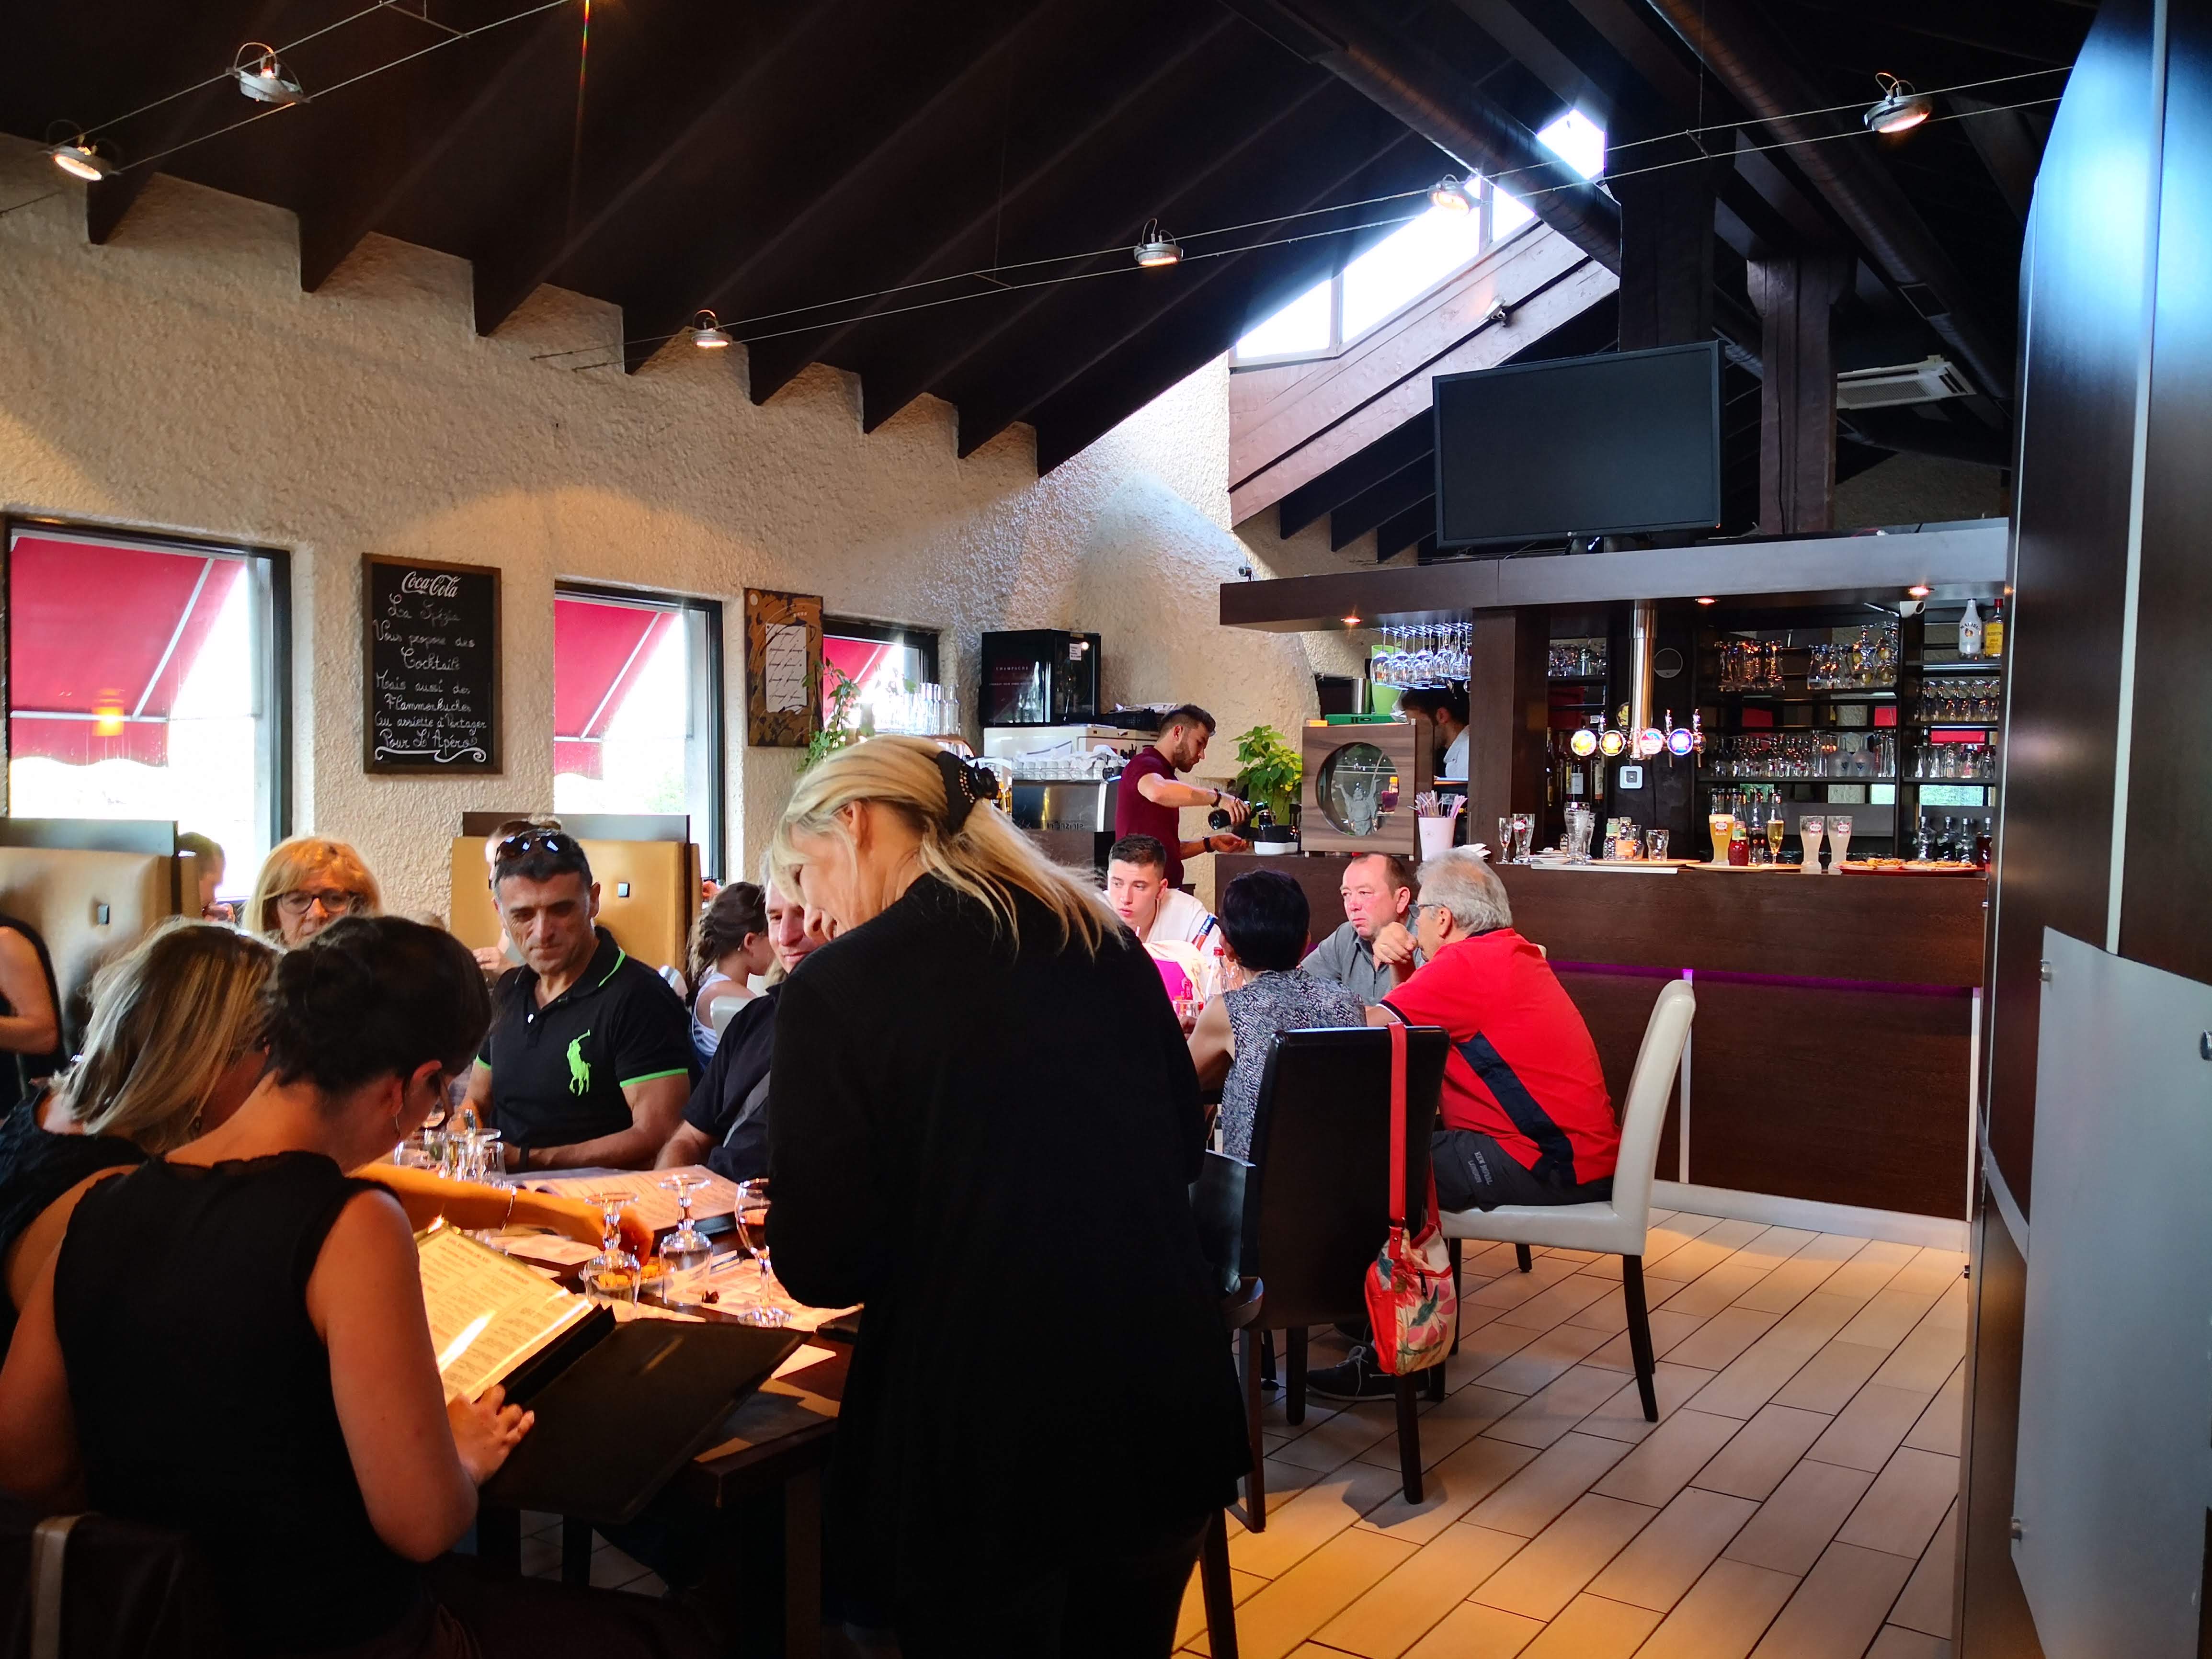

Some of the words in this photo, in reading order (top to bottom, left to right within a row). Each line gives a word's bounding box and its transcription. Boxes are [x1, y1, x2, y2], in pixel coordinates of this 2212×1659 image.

[401, 571, 462, 597] Coca-Cola
[373, 619, 402, 642] Vous
[455, 636, 476, 648] des
[400, 647, 460, 670] Cocktails
[375, 669, 406, 690] Mais
[414, 678, 444, 693] aussi
[452, 680, 471, 694] des
[397, 716, 434, 727] assiette
[379, 728, 410, 749] Pour
